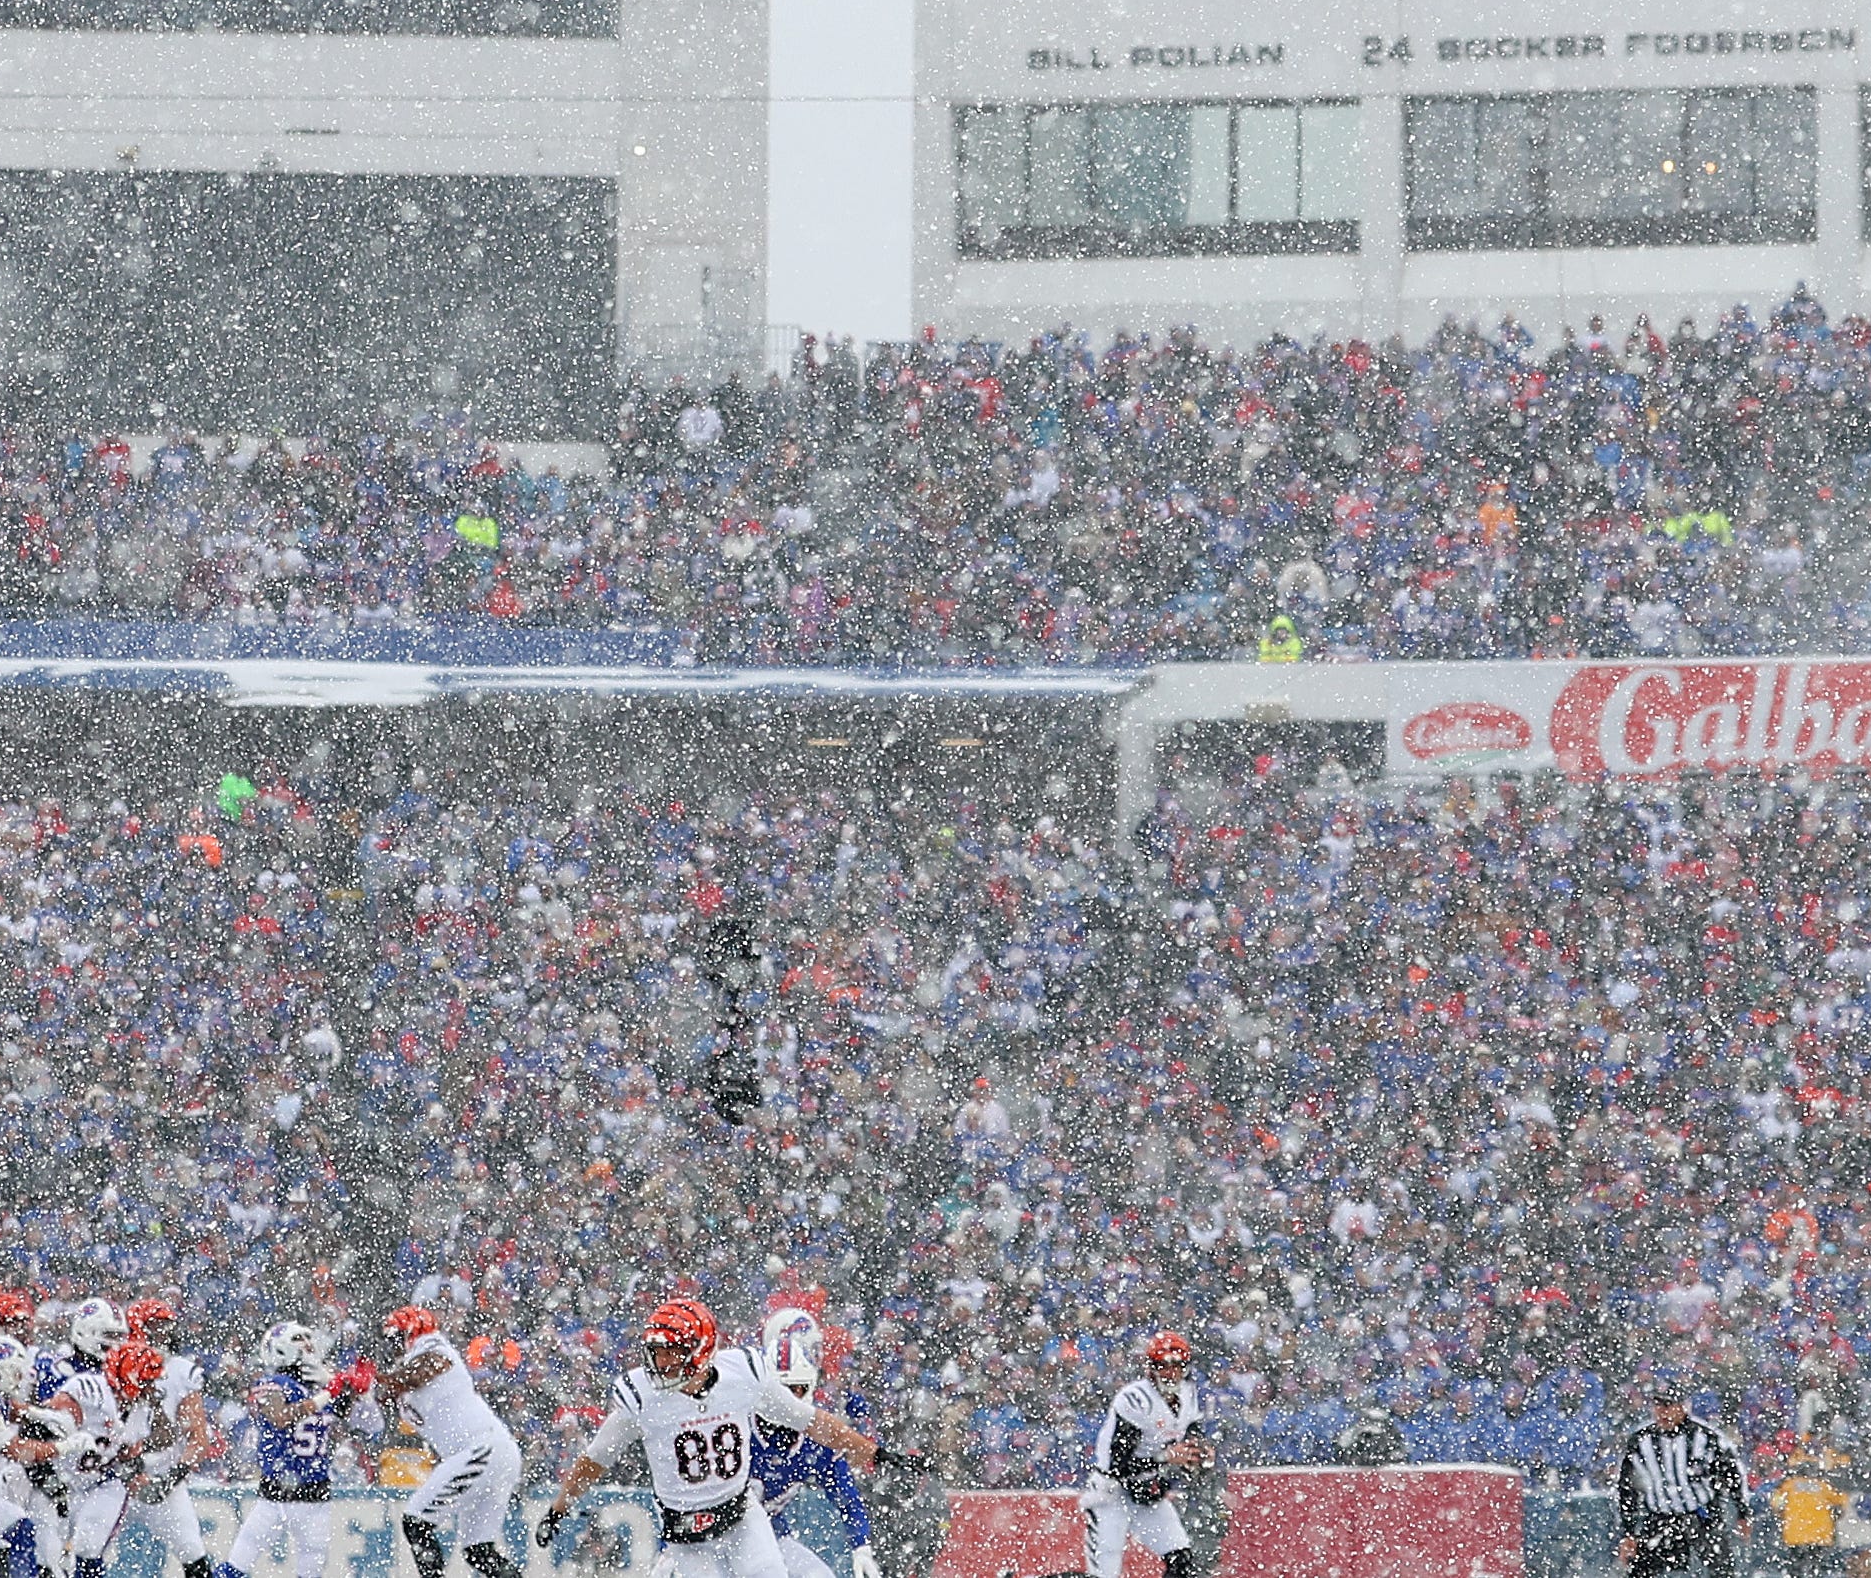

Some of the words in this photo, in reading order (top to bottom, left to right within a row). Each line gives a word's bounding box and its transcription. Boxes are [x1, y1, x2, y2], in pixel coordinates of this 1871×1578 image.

[1027, 47, 1112, 70] BILL
[1130, 44, 1286, 69] POLIAN
[1361, 34, 1413, 68] 24
[674, 1423, 743, 1484] 88
